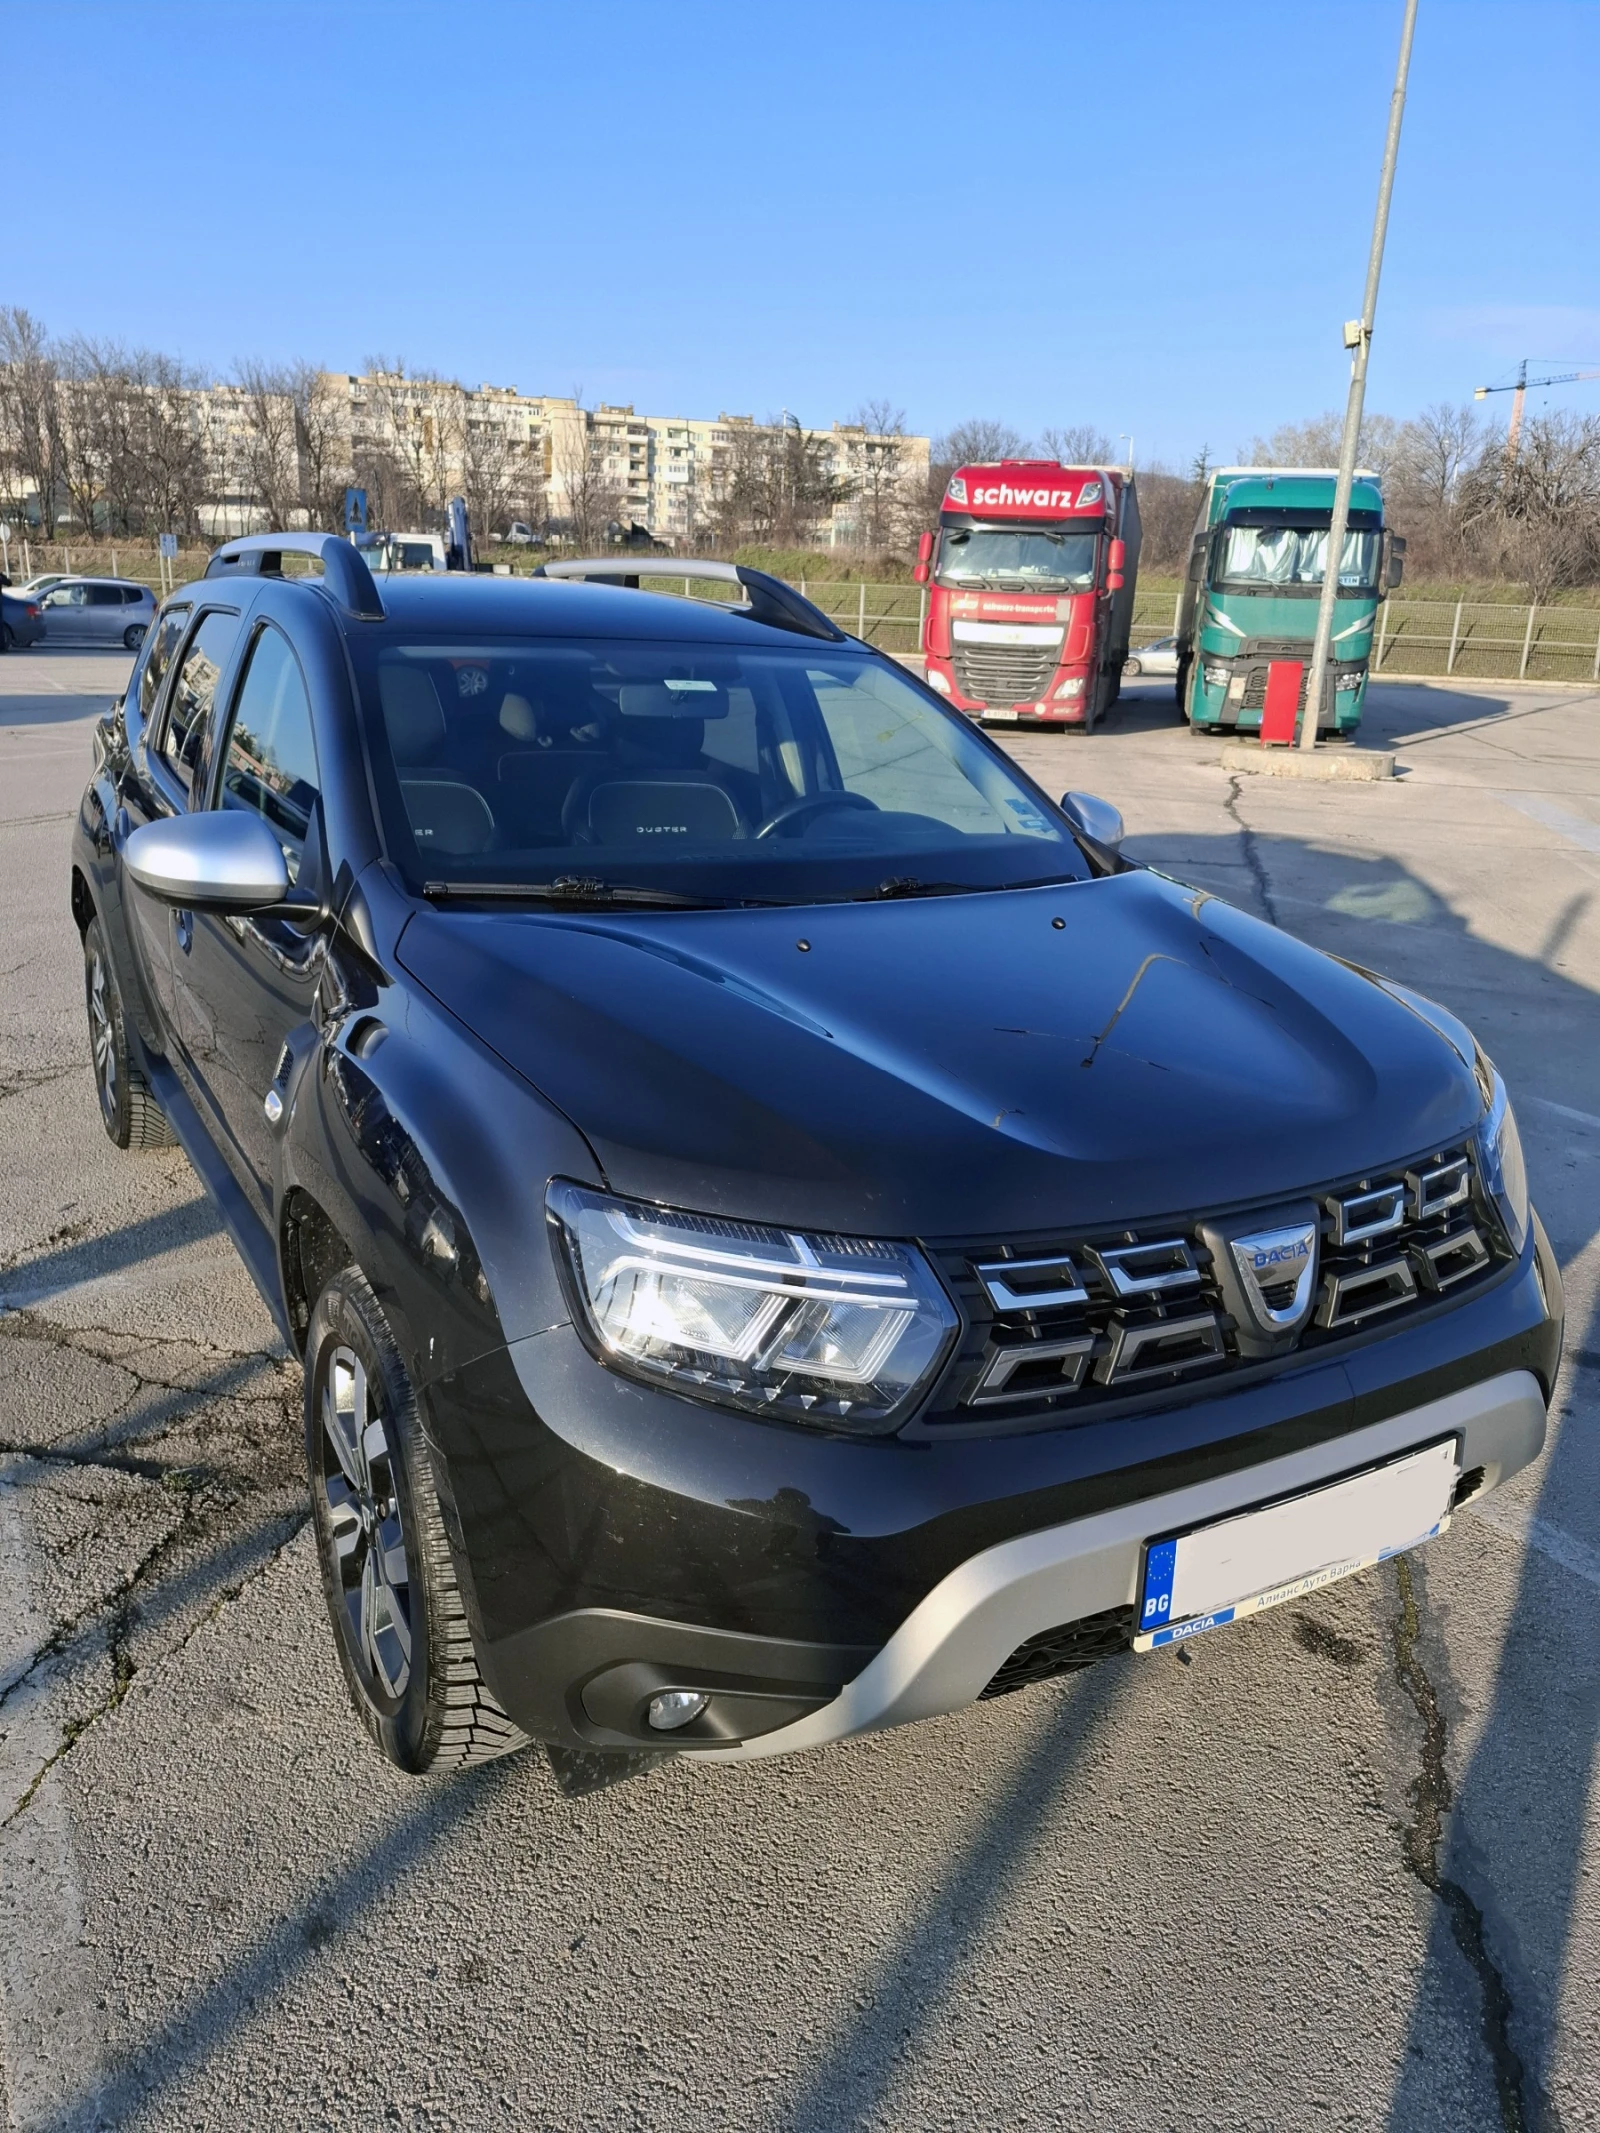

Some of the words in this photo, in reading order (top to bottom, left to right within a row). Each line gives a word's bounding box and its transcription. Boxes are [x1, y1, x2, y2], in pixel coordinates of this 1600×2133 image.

[973, 484, 1072, 508] schwarz
[1254, 1240, 1308, 1267] DACIA
[1257, 1586, 1299, 1607] Алианс
[1302, 1574, 1327, 1592] Ауто
[1330, 1560, 1361, 1580] Варна
[1144, 1593, 1169, 1617] BG
[1172, 1616, 1215, 1638] DACIA
